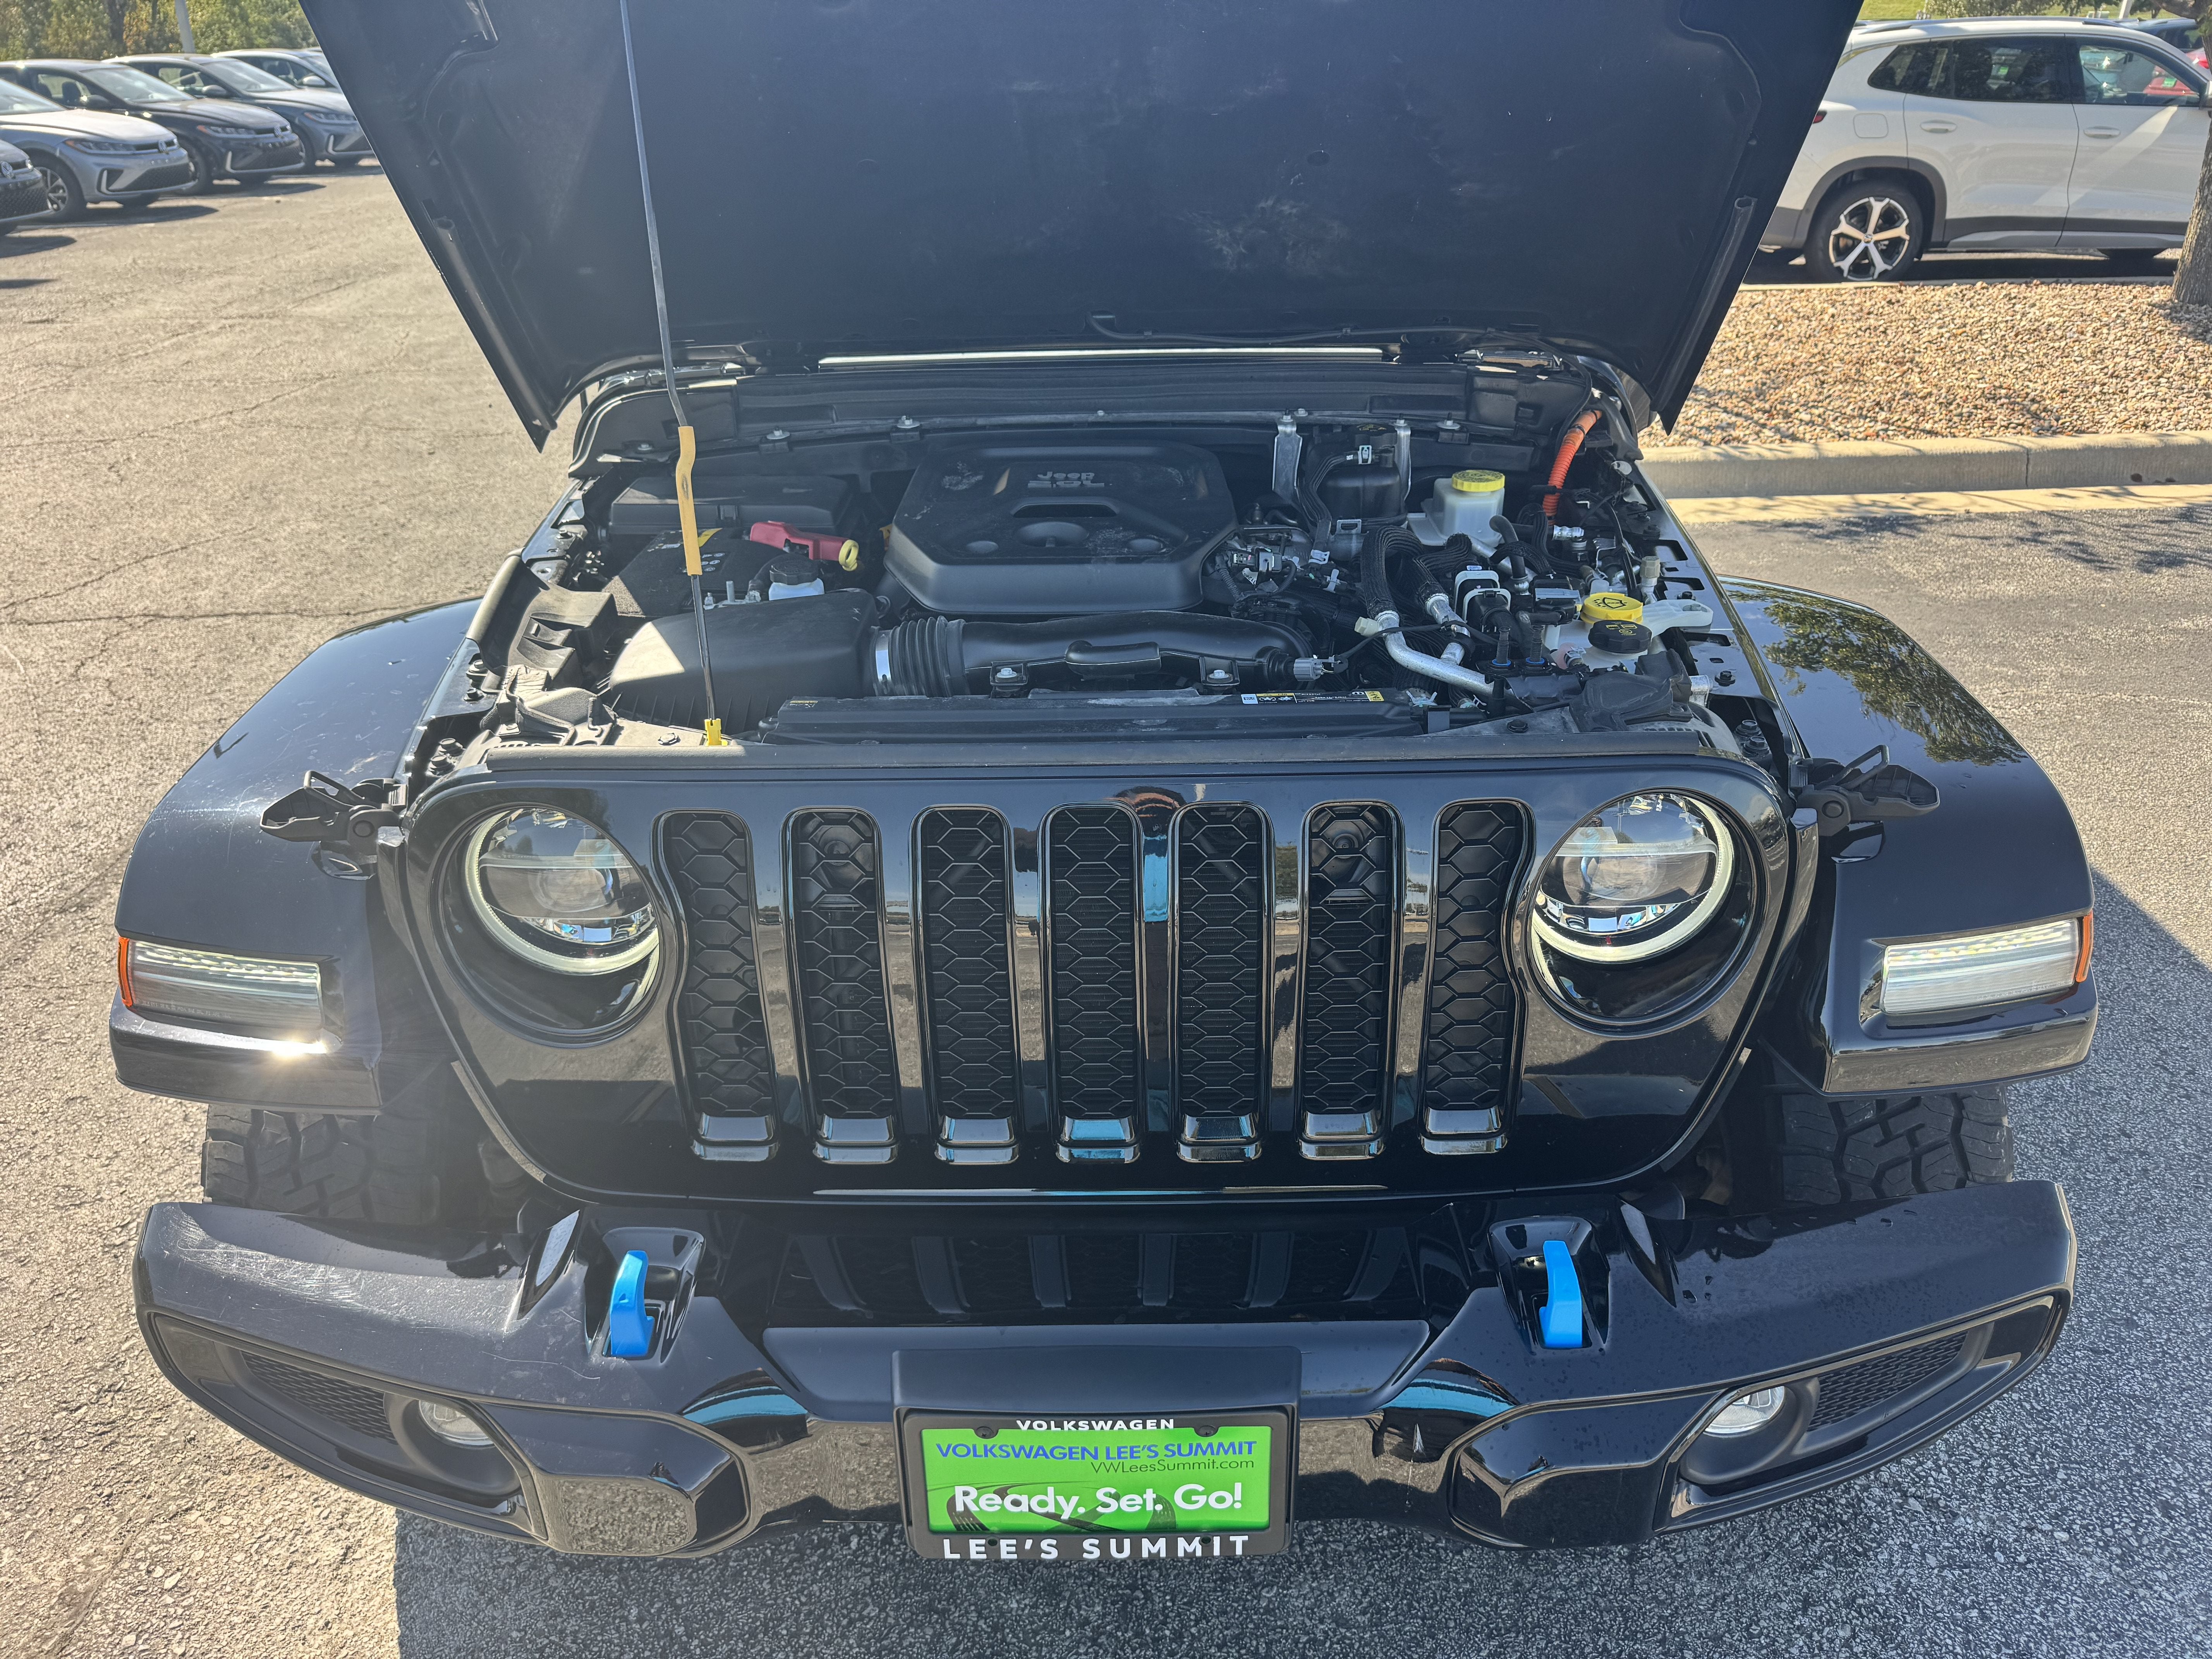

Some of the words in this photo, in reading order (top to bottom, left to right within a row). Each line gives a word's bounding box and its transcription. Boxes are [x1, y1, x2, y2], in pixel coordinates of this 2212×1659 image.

[1037, 471, 1095, 480] Jeep
[1016, 1419, 1174, 1431] VOLKSWAGEN
[936, 1443, 1099, 1460] VOLKSWAGEN
[1105, 1444, 1159, 1460] LEE'S
[1164, 1441, 1257, 1458] SUMMIT
[1091, 1458, 1254, 1474] VWLeesSummit.com
[954, 1485, 1086, 1520] Ready.
[1096, 1487, 1163, 1513] Set.
[1174, 1482, 1242, 1510] Go!
[943, 1538, 1059, 1559] LEE'S
[1082, 1535, 1249, 1559] SUMMIT
